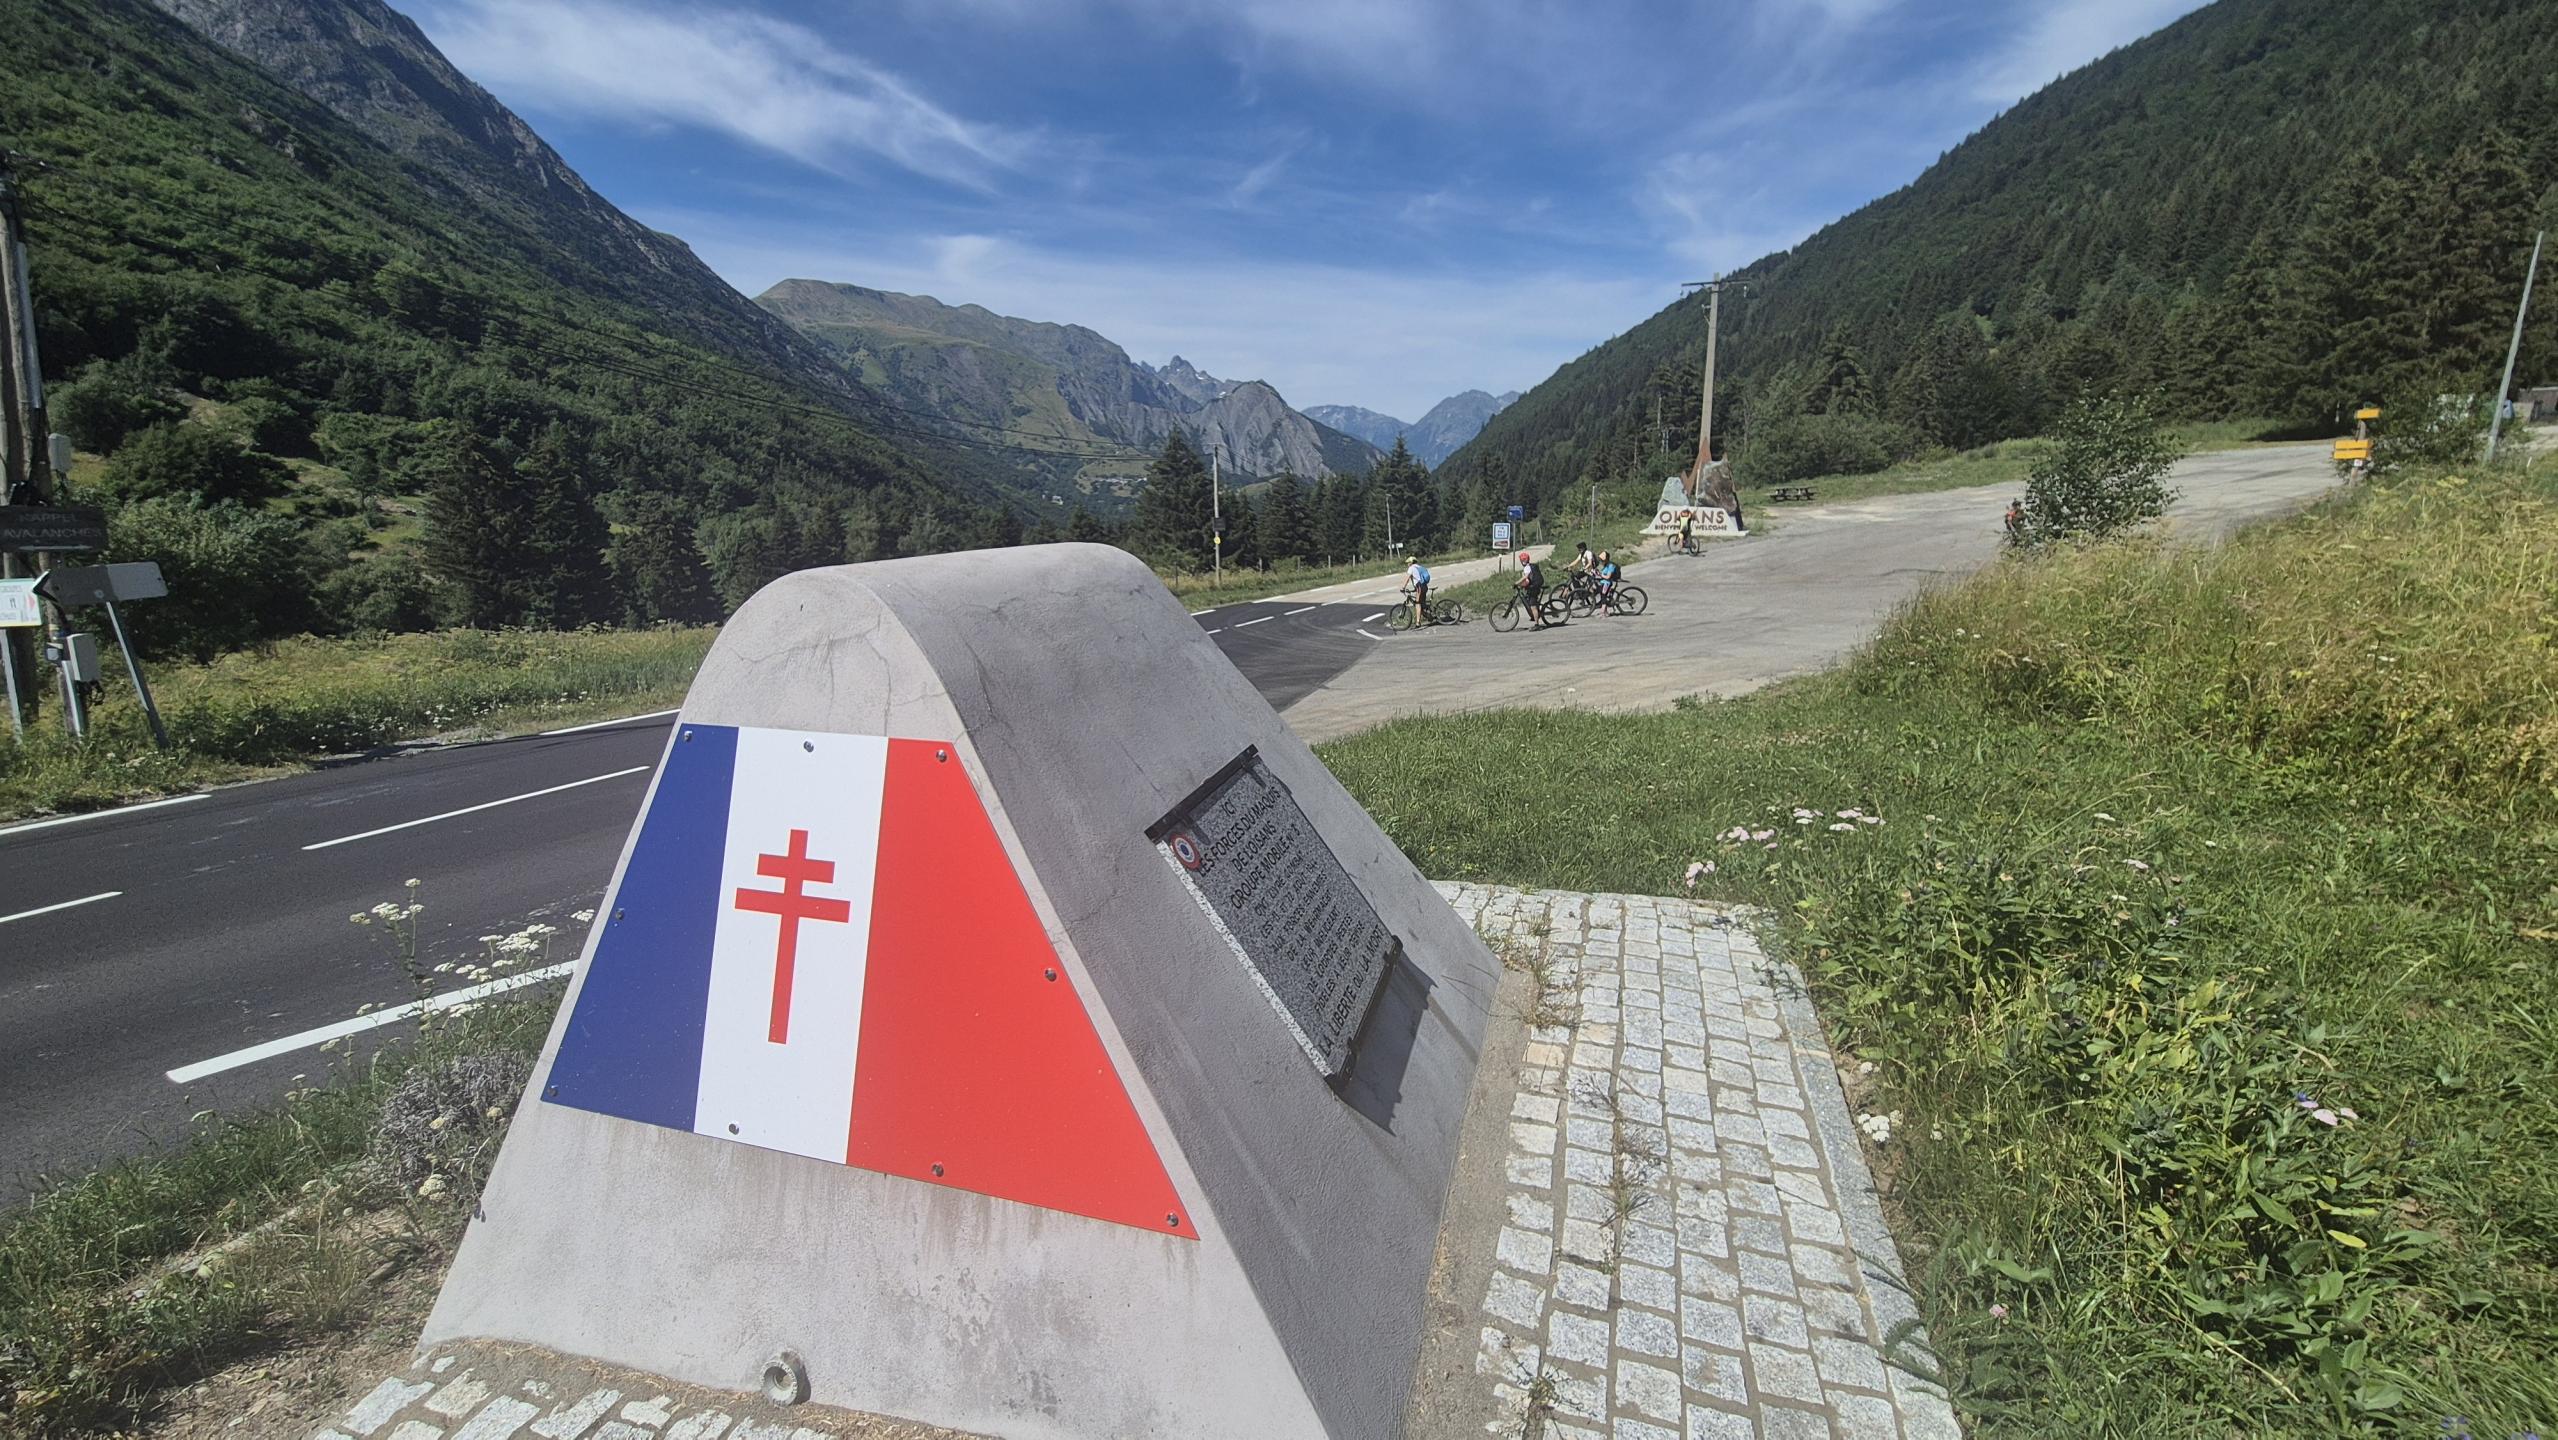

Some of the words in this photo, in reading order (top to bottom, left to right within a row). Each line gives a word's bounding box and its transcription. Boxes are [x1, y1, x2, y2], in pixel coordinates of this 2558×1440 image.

[1660, 511, 1724, 523] OIANS
[4, 528, 102, 538] AVALANCHES
[1220, 797, 1238, 818] ICI
[1193, 852, 1216, 879] LES
[1209, 821, 1246, 863] FORCES
[1239, 809, 1257, 831] DU
[1249, 783, 1282, 822] MAQUIS
[1231, 851, 1248, 873] DE
[1228, 863, 1266, 912] GROUPE
[1259, 835, 1290, 874] MOBILE
[1259, 919, 1274, 940] LES
[1306, 976, 1318, 994] DE
[1318, 1031, 1335, 1059] LA
[1328, 983, 1356, 1037] LIBERTE
[1351, 968, 1364, 989] OU
[1358, 951, 1371, 973] LA
[1365, 923, 1384, 957] MORT
